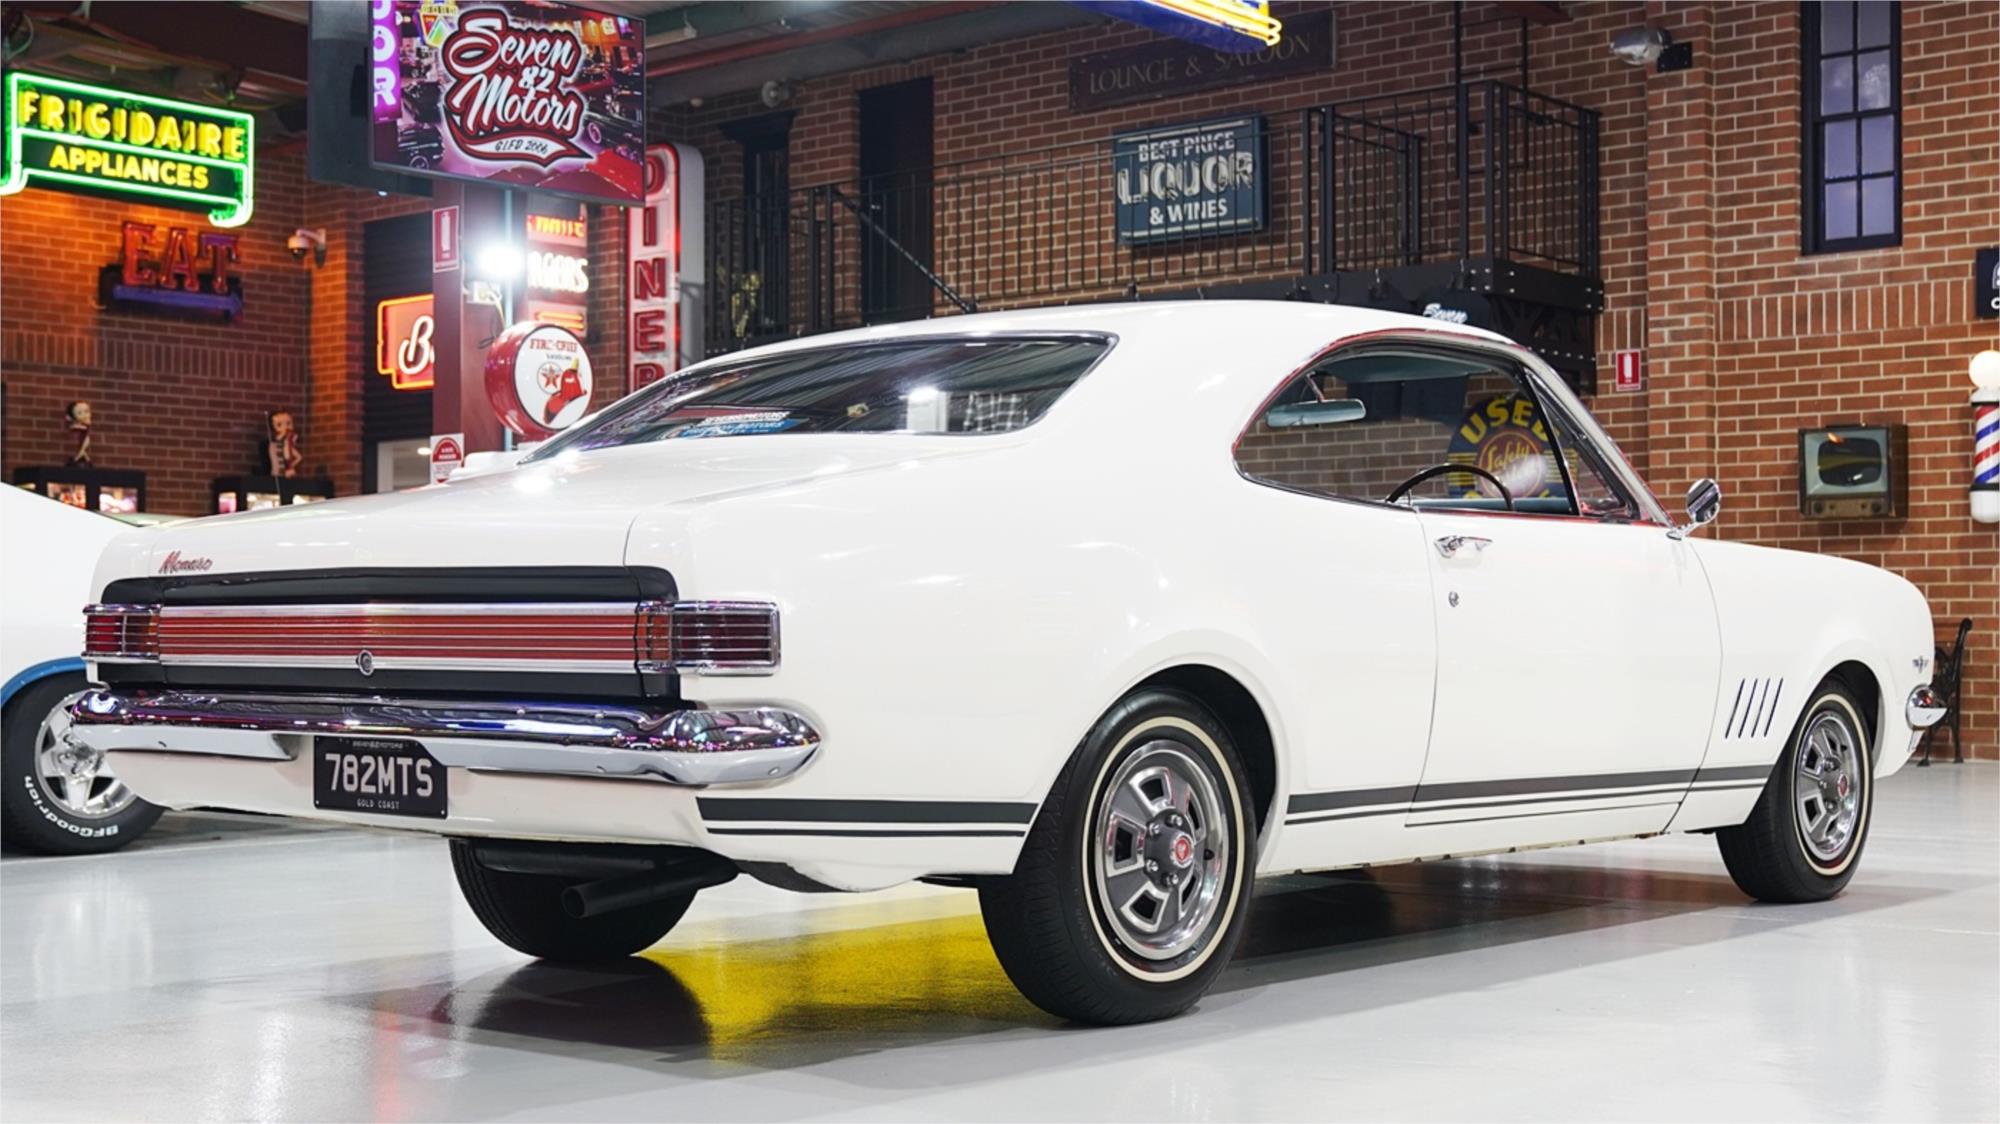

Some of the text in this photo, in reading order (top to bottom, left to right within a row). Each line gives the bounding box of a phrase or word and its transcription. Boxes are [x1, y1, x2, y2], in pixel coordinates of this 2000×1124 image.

[449, 18, 574, 74] Seven
[1090, 34, 1311, 94] LOUNGE & SALOON
[452, 73, 579, 132] Motors
[518, 67, 555, 93] 82
[19, 90, 245, 161] FRIGIDAIRE
[1138, 131, 1235, 162] BEST PRICE
[49, 145, 209, 190] APPLIANCES
[1117, 151, 1254, 205] LIQUOR
[1150, 199, 1228, 226] & WINES
[121, 220, 240, 294] EAT
[1486, 440, 1530, 473] Safety
[158, 550, 213, 574] Monaro
[325, 753, 433, 797] 782MTS
[23, 775, 120, 838] BFGoodrich
[356, 798, 400, 810] GOLD COAST
